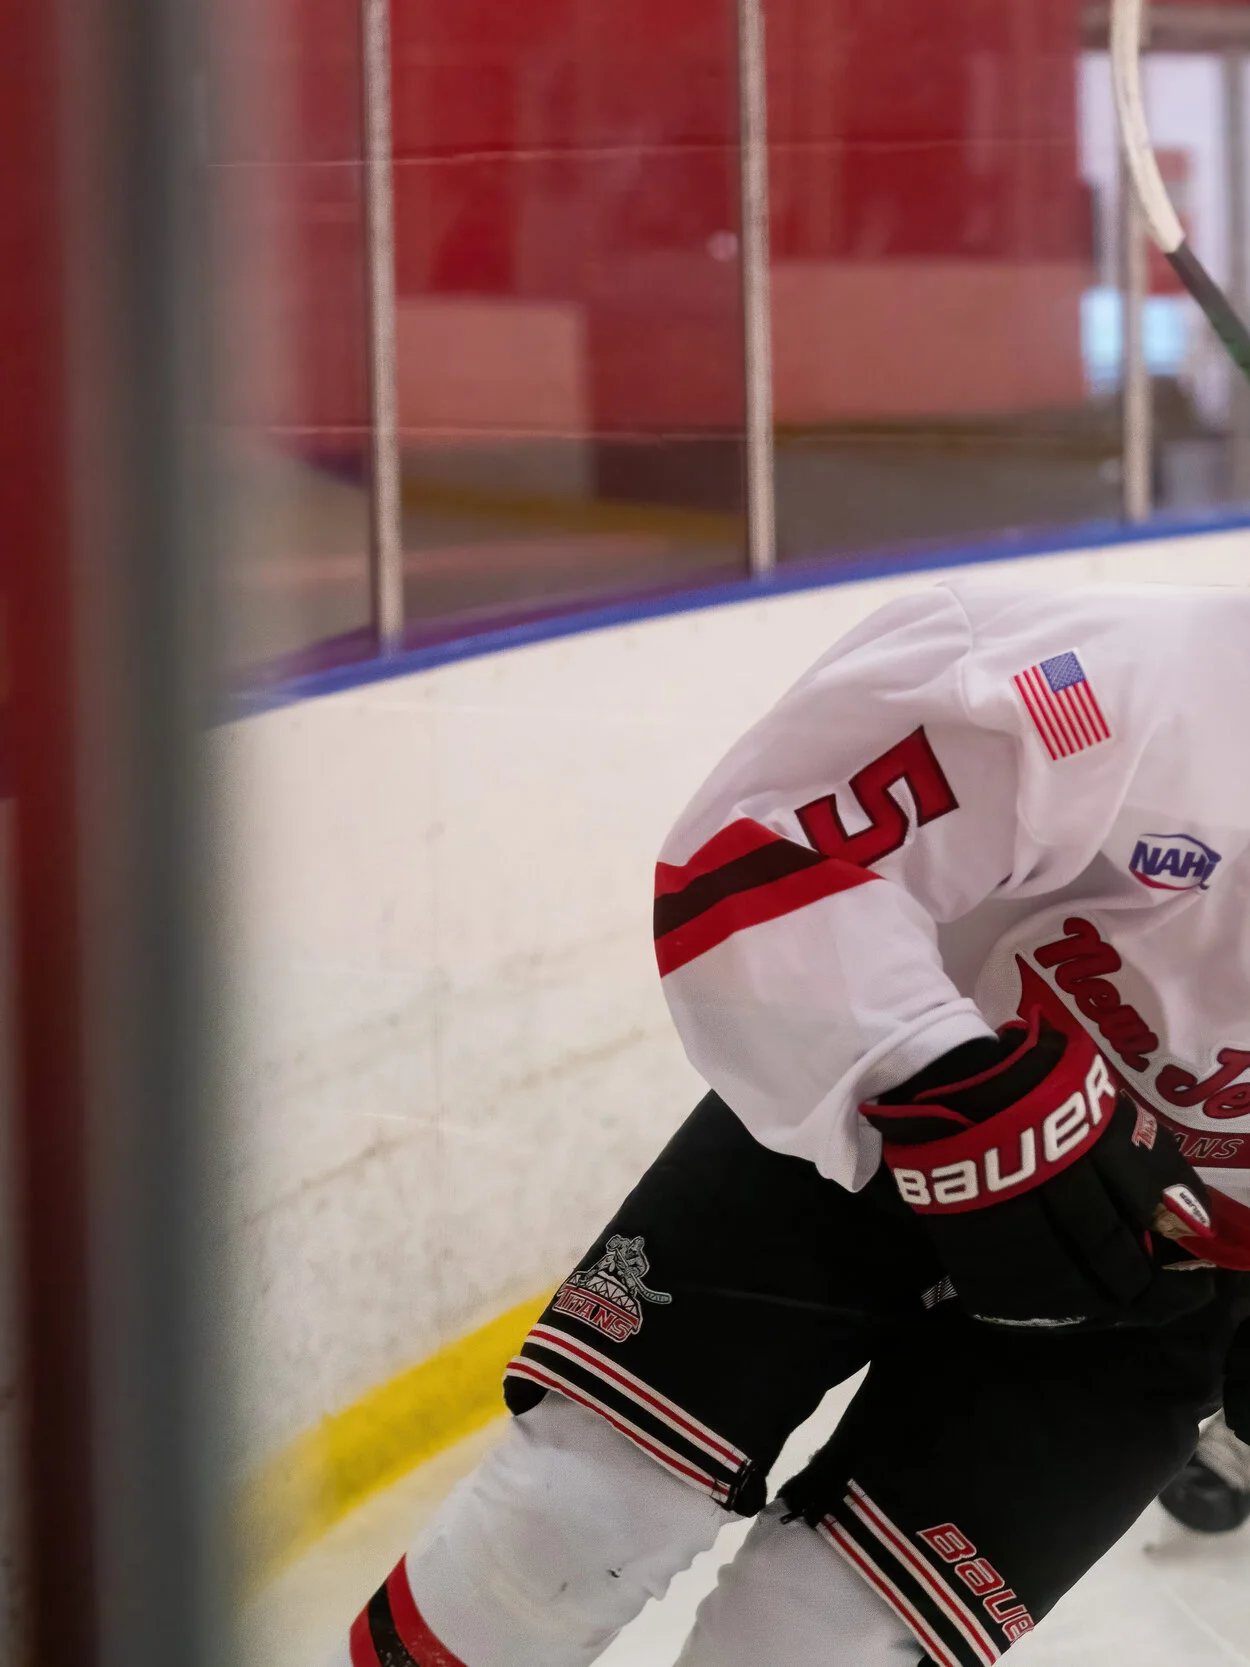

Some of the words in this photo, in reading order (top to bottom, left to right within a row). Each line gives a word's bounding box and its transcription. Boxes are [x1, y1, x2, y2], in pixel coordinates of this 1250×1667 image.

[794, 725, 959, 868] 5
[1034, 916, 1158, 1073] New
[893, 1053, 1116, 1207] BAUER
[553, 1284, 641, 1342] TITANS
